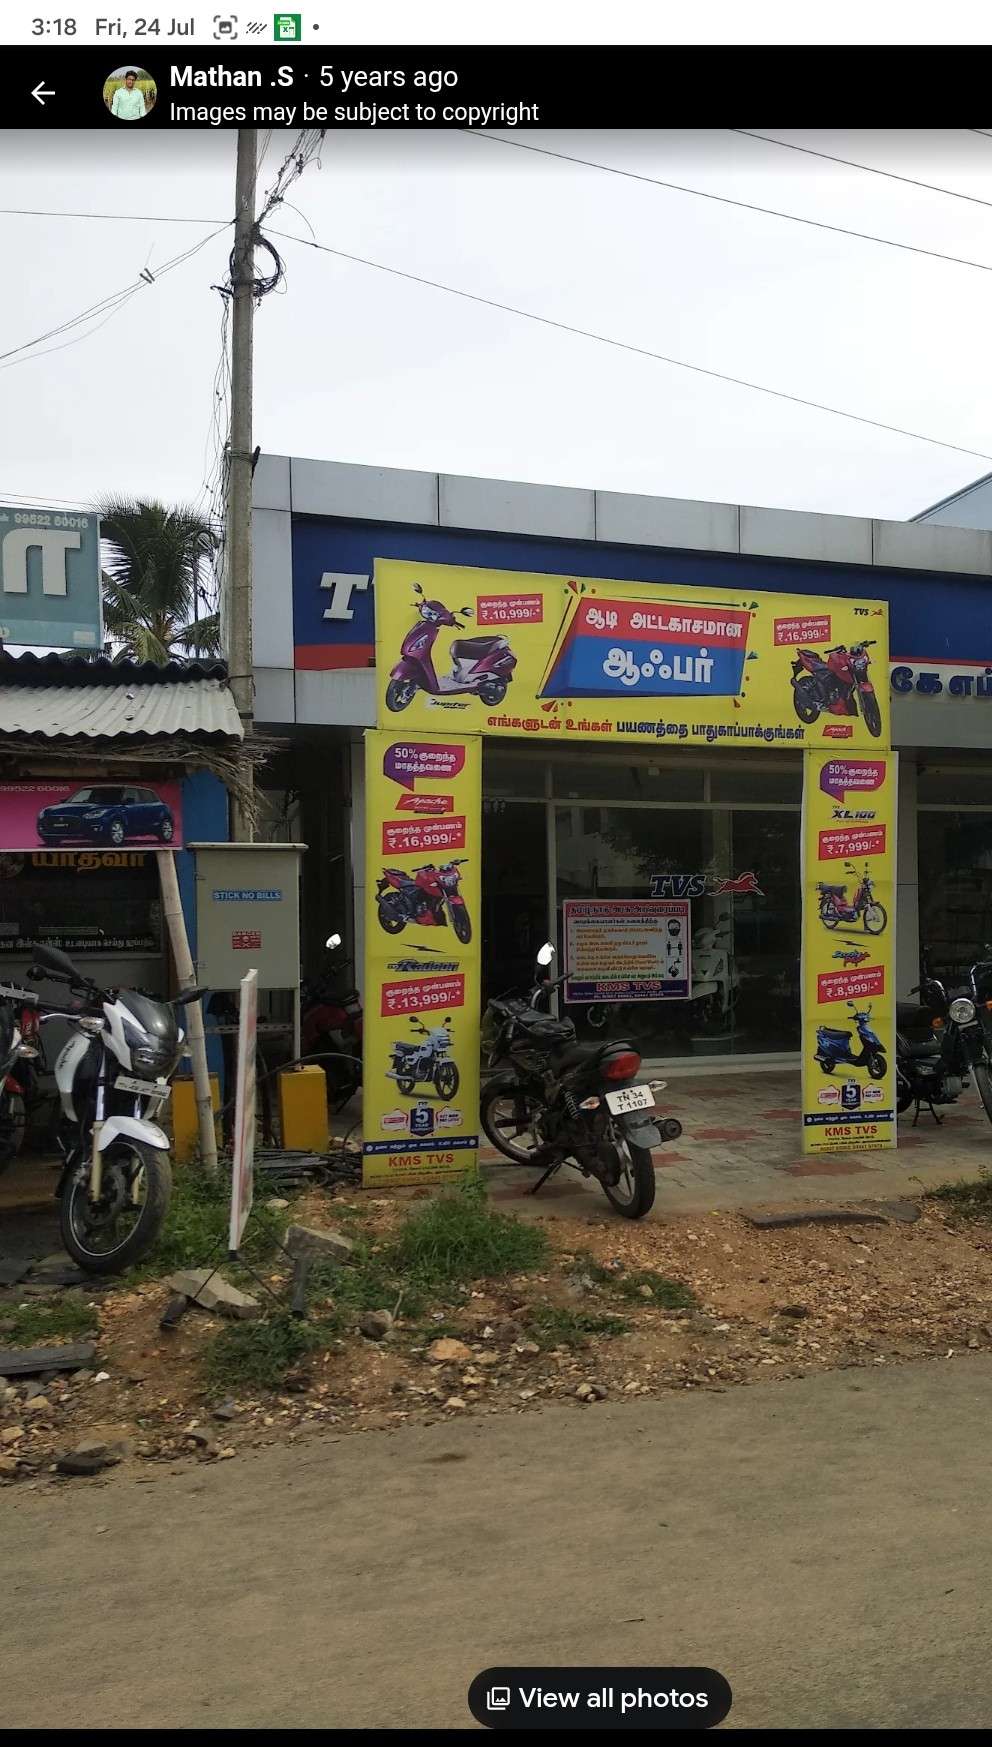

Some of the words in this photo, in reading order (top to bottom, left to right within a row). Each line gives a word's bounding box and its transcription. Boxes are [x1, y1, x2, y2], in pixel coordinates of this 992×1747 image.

[854, 608, 869, 616] TVS
[586, 608, 618, 630] ஆடி
[630, 612, 743, 637] அட்டகாசமான
[603, 647, 714, 686] ஆஃபர்
[487, 714, 562, 732] எங்களுடன்
[565, 718, 612, 732] உங்கள்
[616, 718, 688, 739] பயணத்தை
[395, 748, 418, 759] 50%
[829, 765, 847, 774] 50%
[650, 874, 706, 896] TVS
[214, 891, 240, 899] STICK
[242, 891, 255, 899] NO
[257, 891, 281, 899] BILLS
[596, 982, 630, 992] KMS
[632, 981, 662, 991] TVS
[616, 1094, 630, 1102] TN
[632, 1091, 644, 1099] 34
[627, 1099, 647, 1108] 1107
[825, 1127, 851, 1136] KMS
[855, 1125, 878, 1134] TVS
[388, 1155, 421, 1168] KMS
[427, 1153, 454, 1164] TVS
